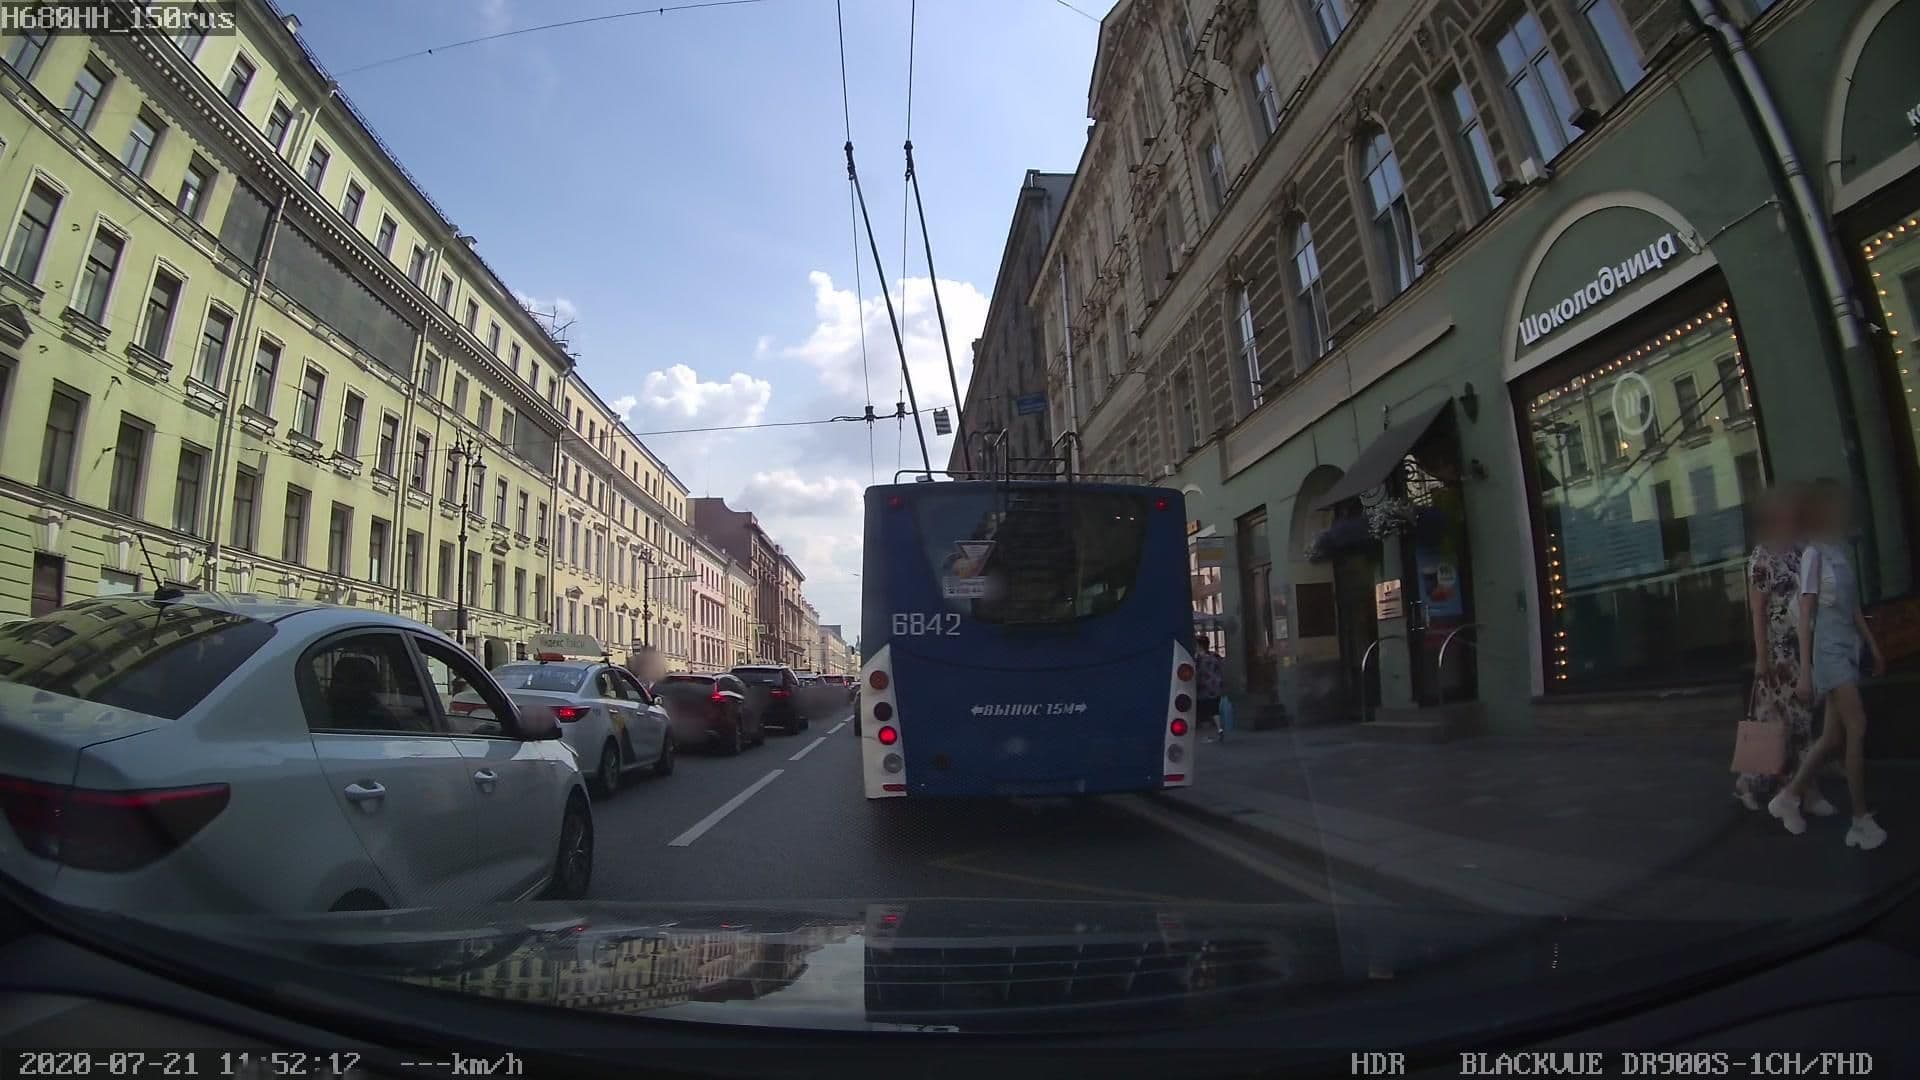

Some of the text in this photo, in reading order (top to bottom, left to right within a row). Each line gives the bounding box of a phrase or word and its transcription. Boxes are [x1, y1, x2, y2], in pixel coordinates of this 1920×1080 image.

[1519, 232, 1678, 346] Шоколадница
[892, 613, 961, 636] 6842
[983, 704, 1043, 716] ВЫНОС
